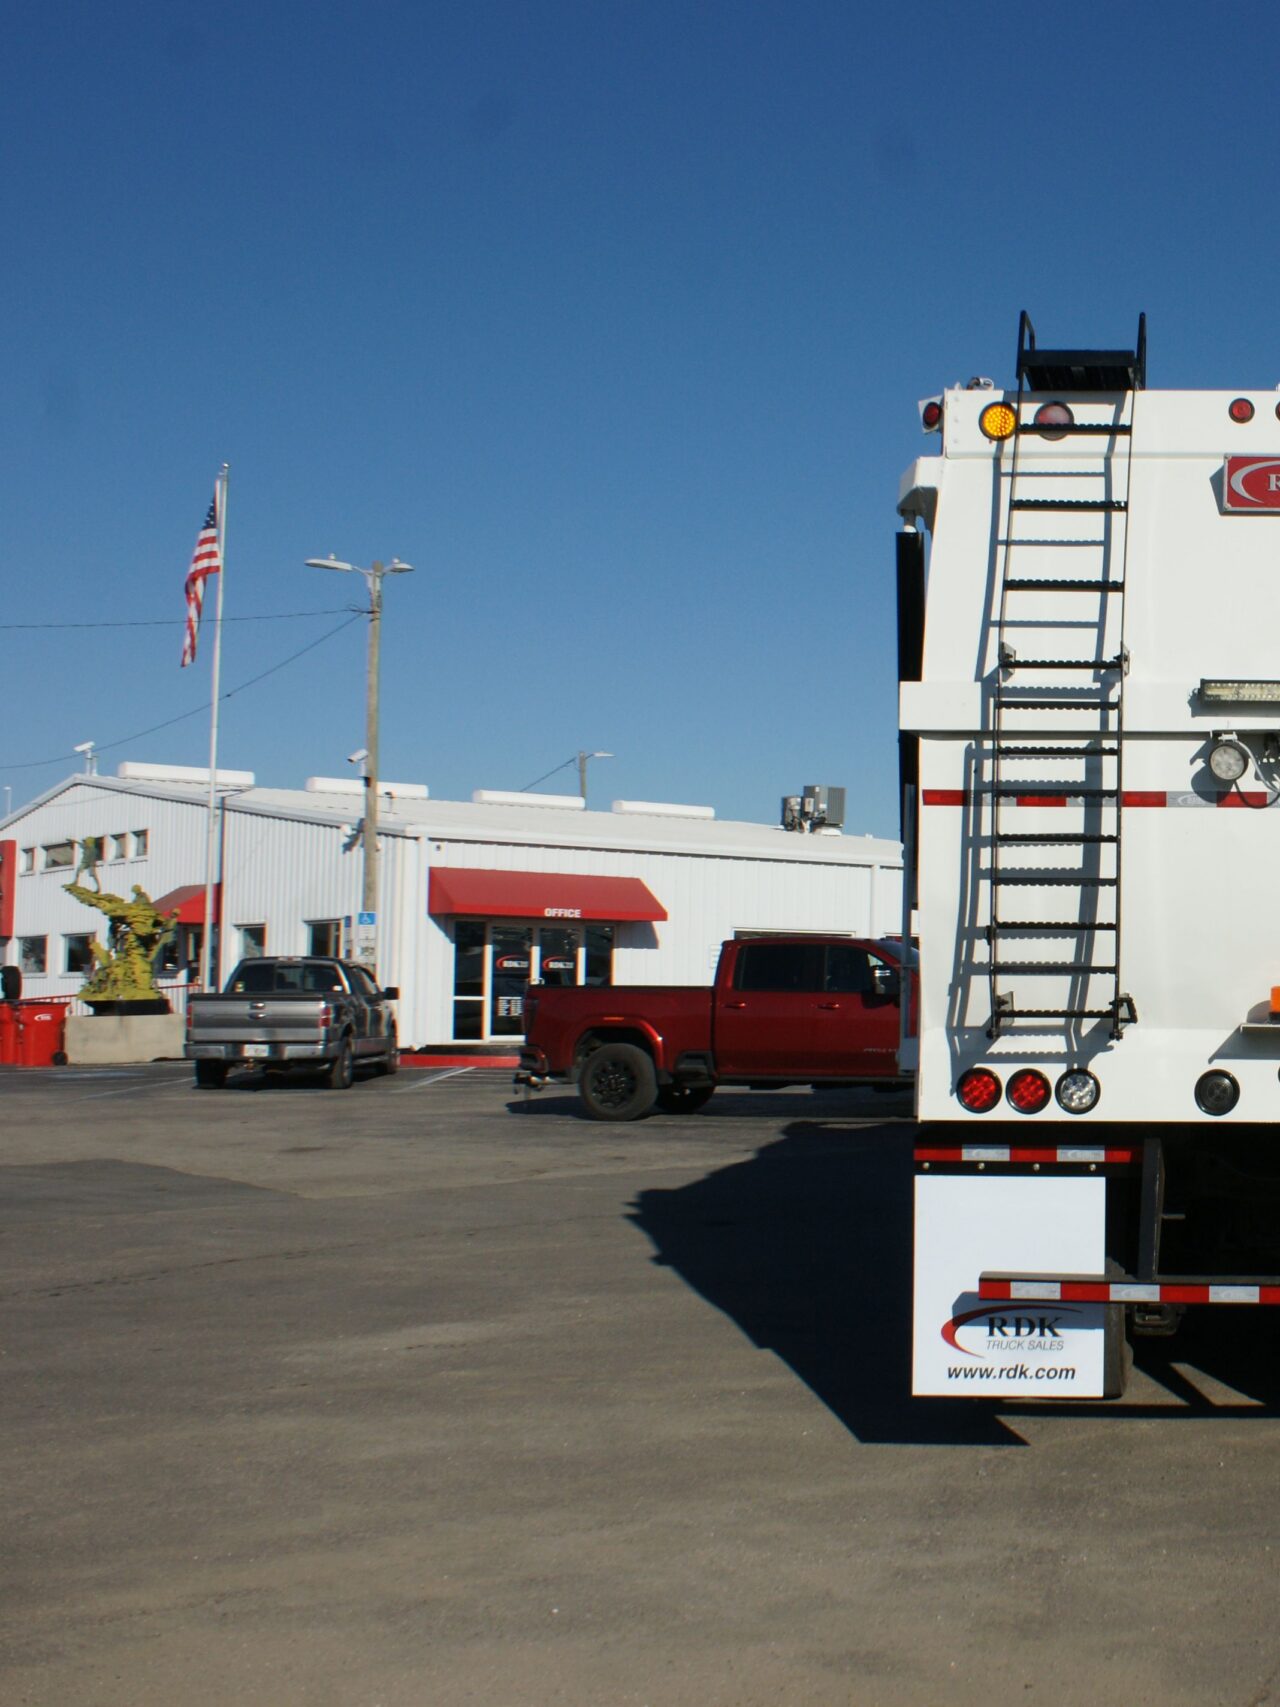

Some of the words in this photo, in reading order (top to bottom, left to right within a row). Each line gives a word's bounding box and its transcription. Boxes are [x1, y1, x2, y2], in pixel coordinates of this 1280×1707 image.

[544, 908, 581, 918] OFFICE
[986, 1316, 1063, 1337] RDK
[987, 1340, 1025, 1351] TRUCK
[1028, 1340, 1064, 1351] SALES
[947, 1364, 1076, 1380] www.rdk.com
